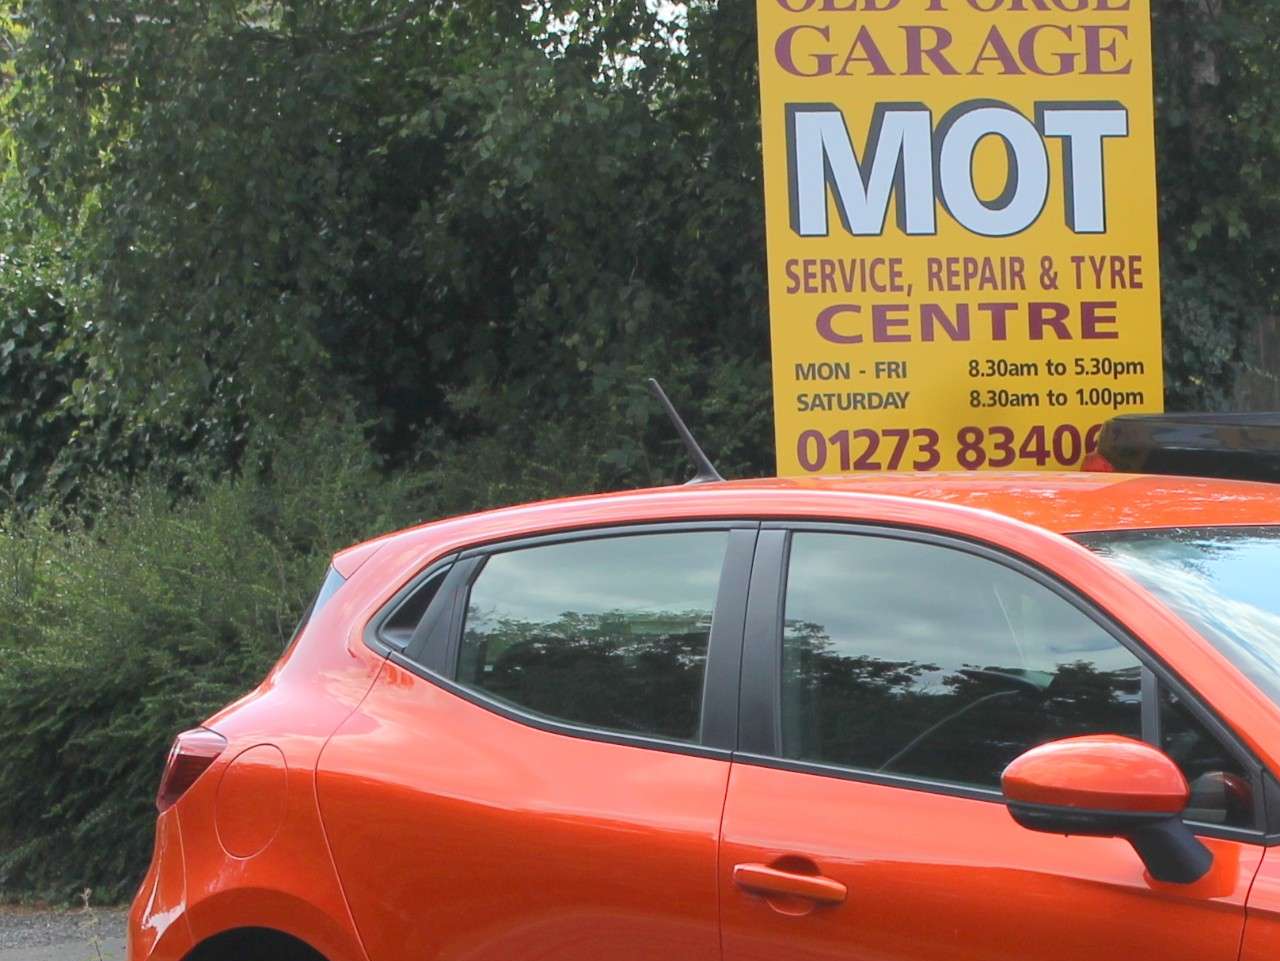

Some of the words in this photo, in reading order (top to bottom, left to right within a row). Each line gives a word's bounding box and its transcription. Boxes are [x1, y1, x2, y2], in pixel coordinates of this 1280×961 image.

[774, 24, 1133, 77] GARAGE
[785, 98, 1129, 237] MOT
[785, 258, 913, 297] SERVICE,
[927, 256, 1026, 292] REPAIR
[1039, 255, 1059, 290] &
[1071, 255, 1143, 290] TYRE
[815, 301, 1119, 344] CENTRE
[795, 362, 850, 381] MON
[875, 361, 907, 379] FRI
[968, 359, 1038, 377] 8.30am
[1046, 359, 1067, 376] to
[1074, 357, 1145, 379] 5.30pm
[797, 391, 911, 411] SATURDAY
[969, 389, 1039, 408] 8.30am
[1047, 389, 1068, 406] to
[1075, 387, 1144, 410] 1.00pm
[797, 428, 941, 472] 01273
